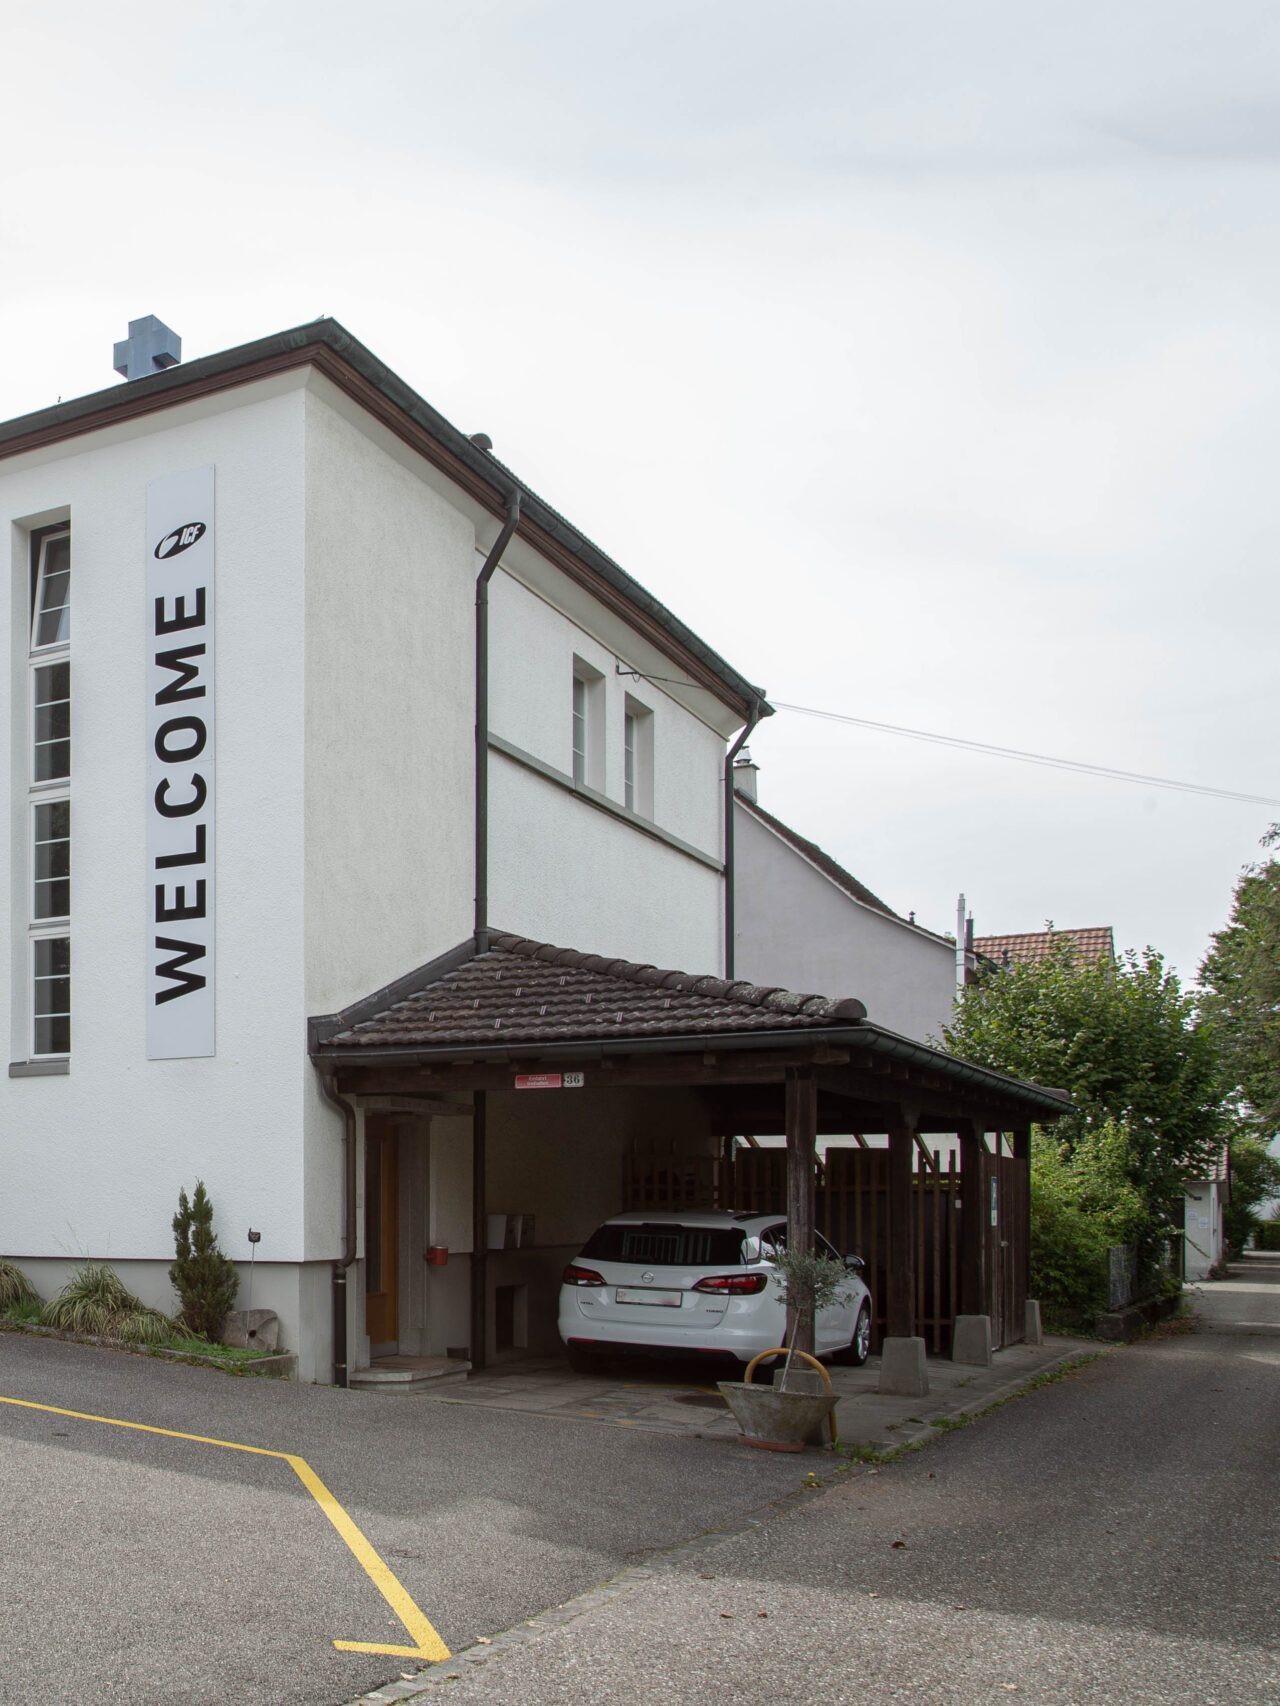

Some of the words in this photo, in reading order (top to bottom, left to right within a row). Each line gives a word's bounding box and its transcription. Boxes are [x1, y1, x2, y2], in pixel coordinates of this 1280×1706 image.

[179, 524, 202, 546] ICF
[154, 586, 208, 1006] WELCOME
[566, 1074, 581, 1085] 36
